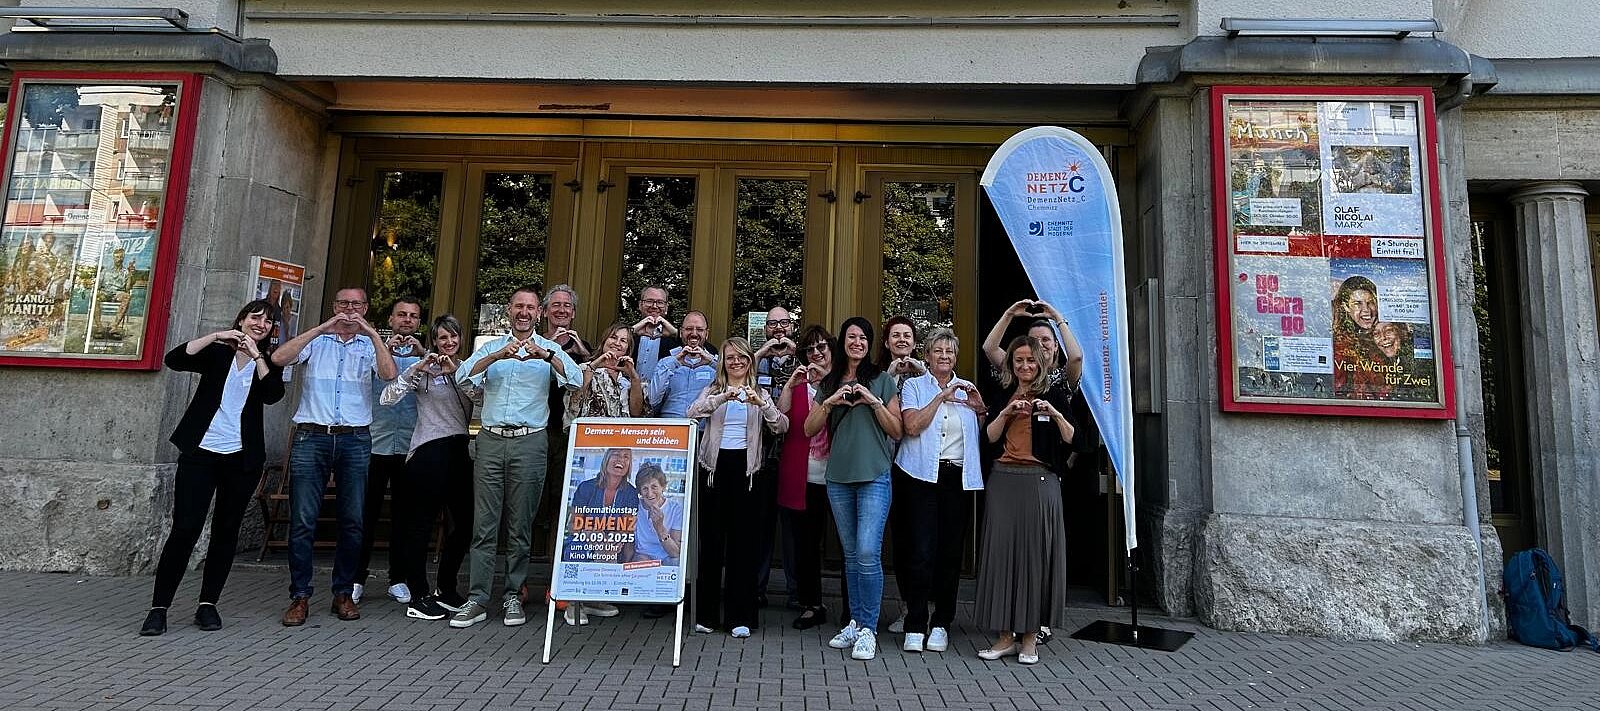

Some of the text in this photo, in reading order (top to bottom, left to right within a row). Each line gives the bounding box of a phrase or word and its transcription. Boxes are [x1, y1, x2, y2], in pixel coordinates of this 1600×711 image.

[1237, 122, 1308, 143] Munch
[1027, 172, 1068, 182] DEMENZ
[1027, 183, 1069, 194] NETZ
[1334, 214, 1374, 222] NICOLAI
[1256, 274, 1278, 294] go
[15, 294, 45, 304] KANU
[1256, 293, 1304, 315] clara
[4, 304, 55, 318] MANITU
[1281, 316, 1305, 336] go
[1100, 292, 1111, 404] Kompetenz verbindet
[1334, 360, 1358, 371] Vier
[1359, 361, 1403, 373] Wände
[1385, 374, 1431, 385] für Zwei
[652, 436, 679, 445] bleiben
[574, 505, 638, 515] Informationstag
[572, 516, 637, 531] DEMENZ
[572, 532, 635, 542] 20.09.2025
[586, 552, 618, 561] Metropol
